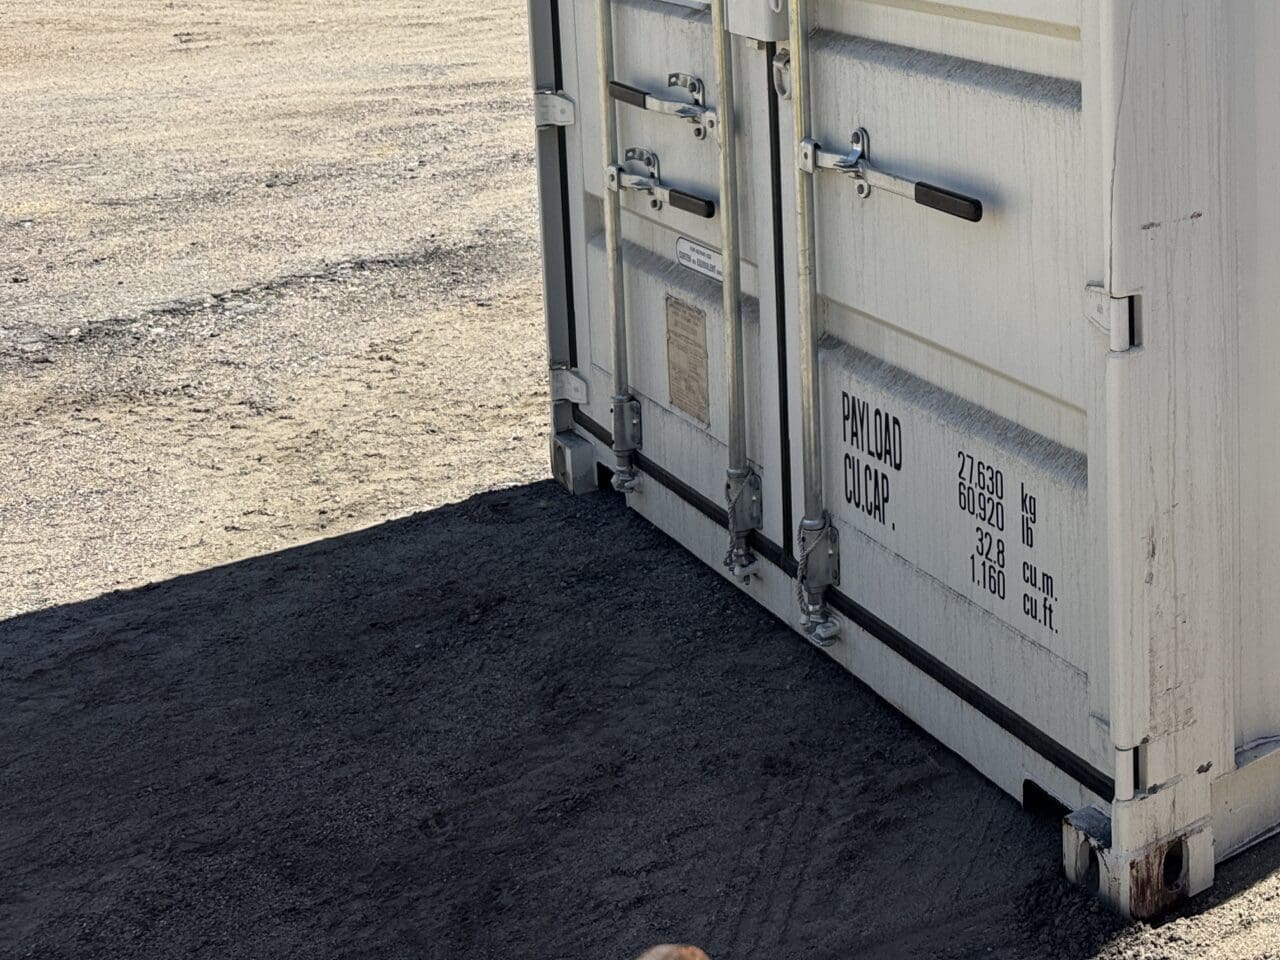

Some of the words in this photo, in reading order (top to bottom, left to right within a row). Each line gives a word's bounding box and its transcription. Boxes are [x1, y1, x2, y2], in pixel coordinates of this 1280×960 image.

[842, 391, 902, 471] PAYLOAD
[1021, 482, 1036, 523] kg
[976, 527, 1005, 568] 32.8
[1022, 514, 1033, 547] lb
